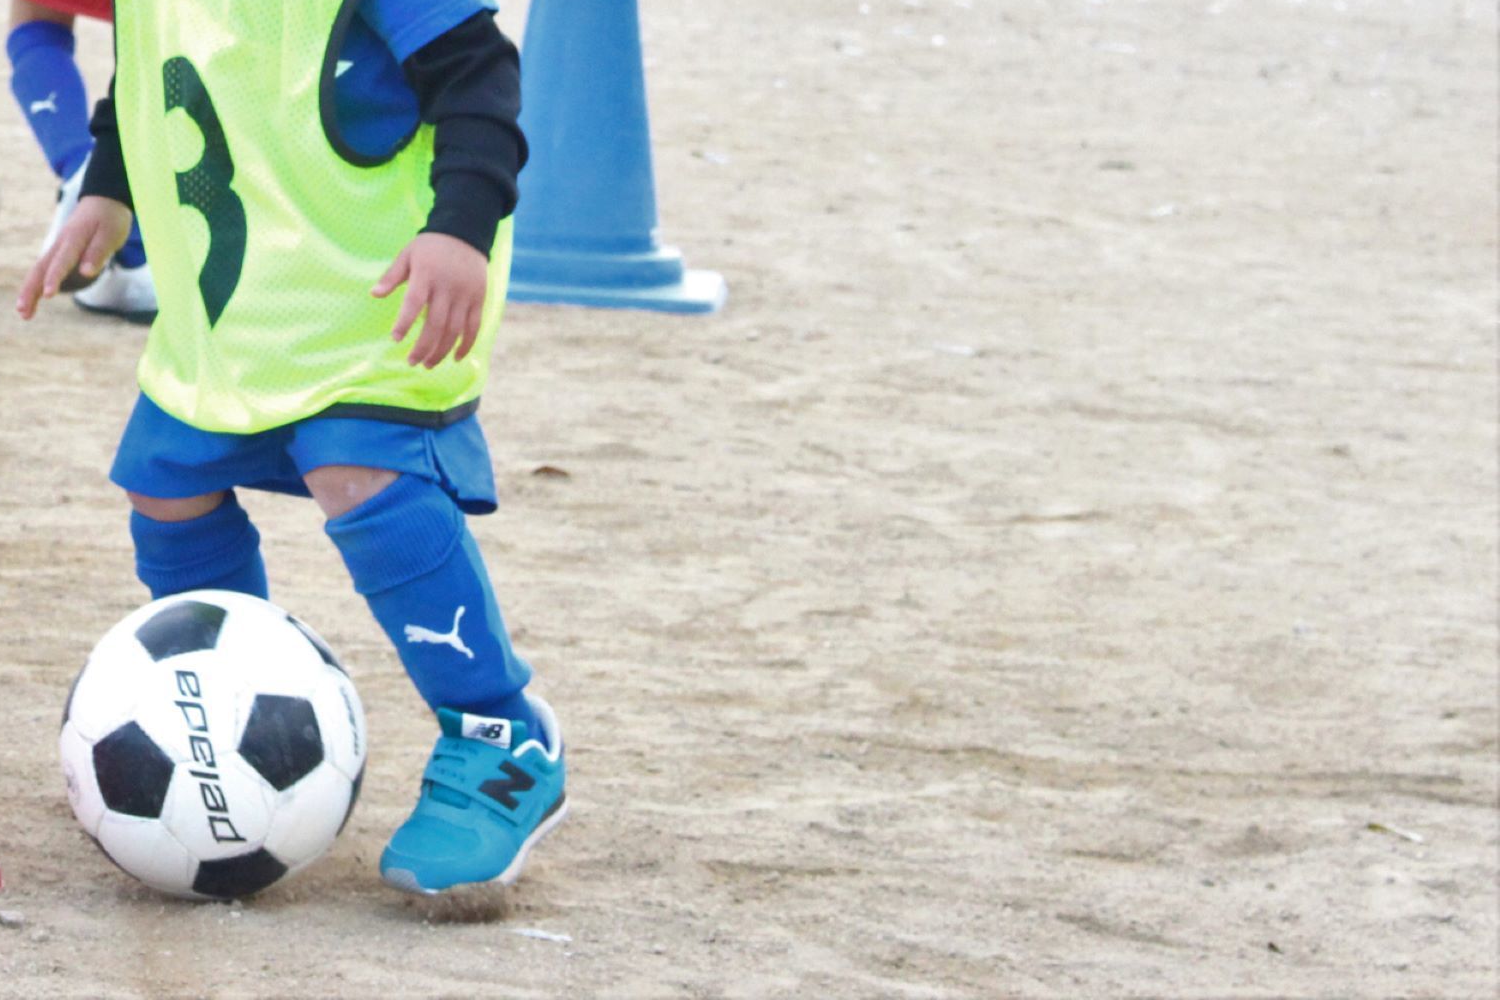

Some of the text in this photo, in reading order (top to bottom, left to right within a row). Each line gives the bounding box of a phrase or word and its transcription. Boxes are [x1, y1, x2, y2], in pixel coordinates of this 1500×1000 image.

[162, 56, 248, 331] 3
[174, 669, 247, 843] pelada
[478, 760, 536, 812] N
